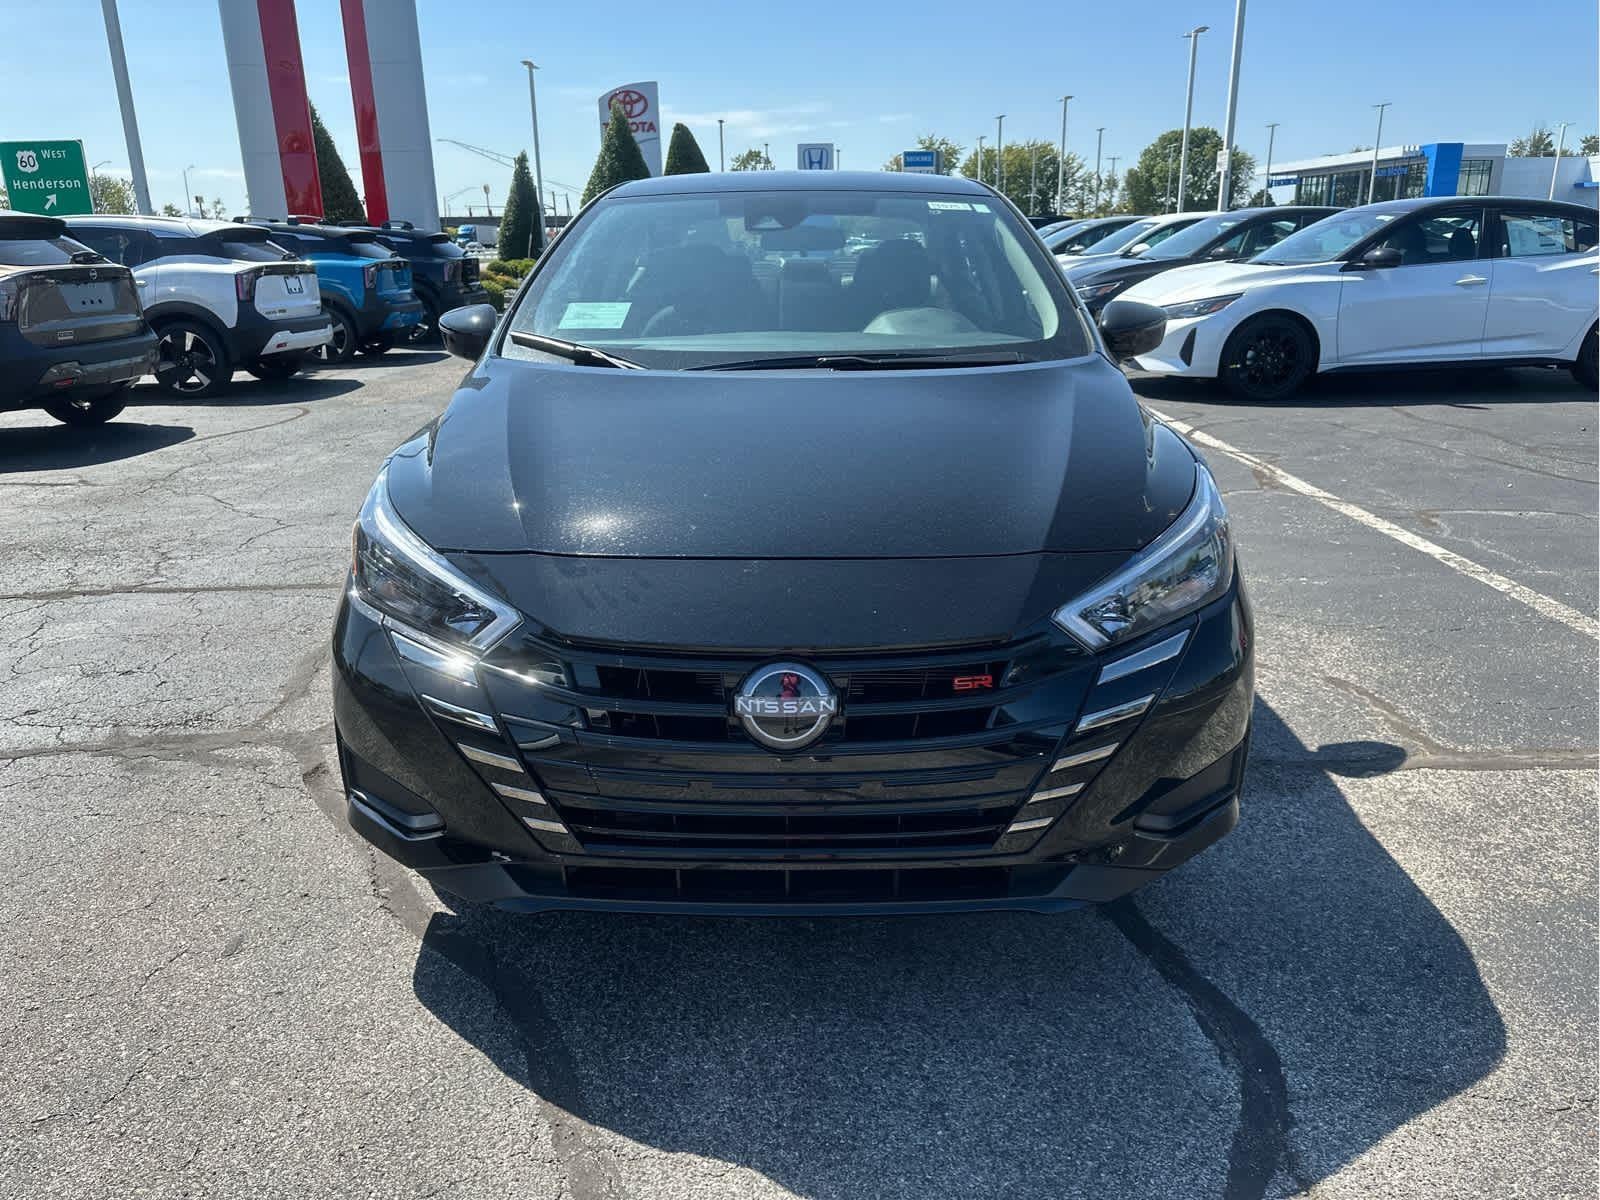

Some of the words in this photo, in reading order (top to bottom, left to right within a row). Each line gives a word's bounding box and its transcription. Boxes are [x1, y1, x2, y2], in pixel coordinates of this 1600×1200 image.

[20, 155, 35, 168] 60
[41, 149, 66, 159] WEST
[13, 178, 81, 190] Henderson
[953, 675, 993, 690] SR
[736, 697, 835, 714] NISSAN
